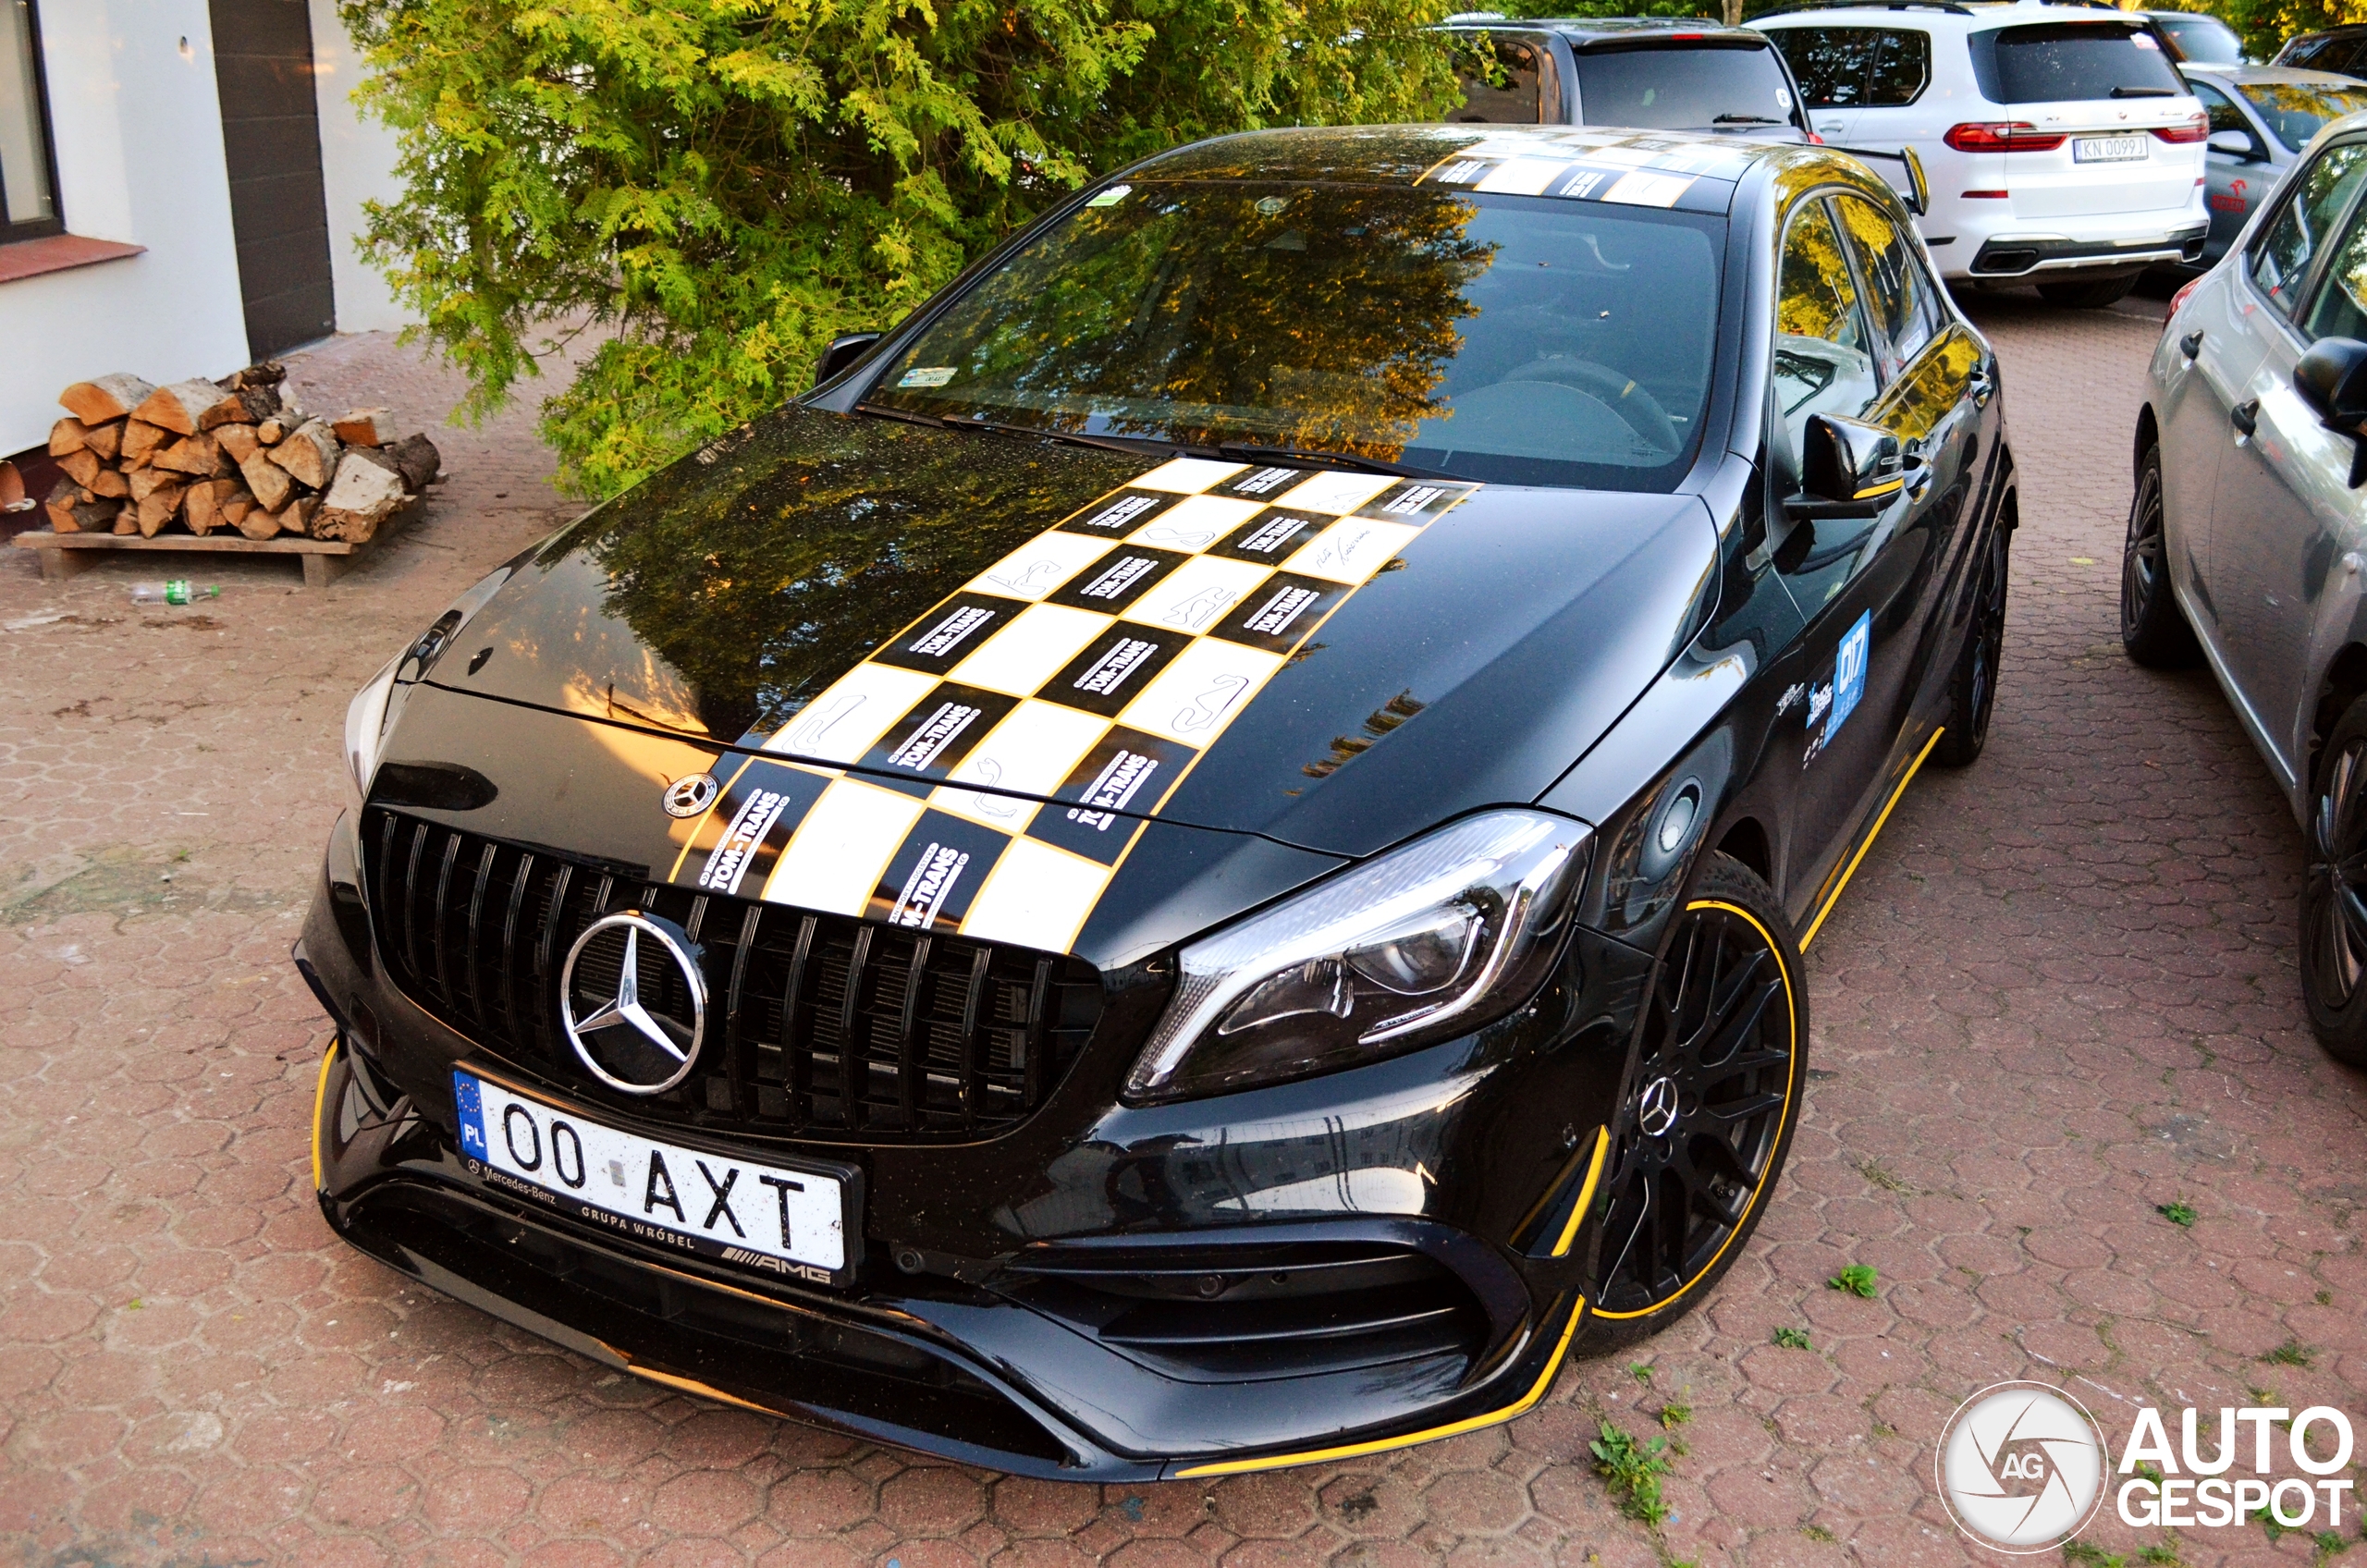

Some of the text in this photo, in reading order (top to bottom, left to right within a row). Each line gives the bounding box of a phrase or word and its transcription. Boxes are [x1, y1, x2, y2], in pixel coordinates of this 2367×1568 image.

[2084, 141, 2102, 157] KN
[1088, 557, 1150, 597] TOM-TRANS
[917, 607, 987, 654] TOM-TRANS
[1252, 588, 1311, 632] TOM-TRANS
[1082, 640, 1149, 692] TOM-TRANS
[896, 704, 972, 767] TOM-TRANS
[707, 830, 733, 868] TRANSPORT
[734, 792, 759, 827] LOGISTYKA
[708, 791, 781, 889] TOM-TRANS
[913, 848, 936, 883] LOGISTYKA
[464, 1123, 484, 1148] PL
[484, 1166, 556, 1205] Mercedes-Benz
[644, 1149, 805, 1251] AXT
[581, 1206, 695, 1249] GRUPA WRÓBEL
